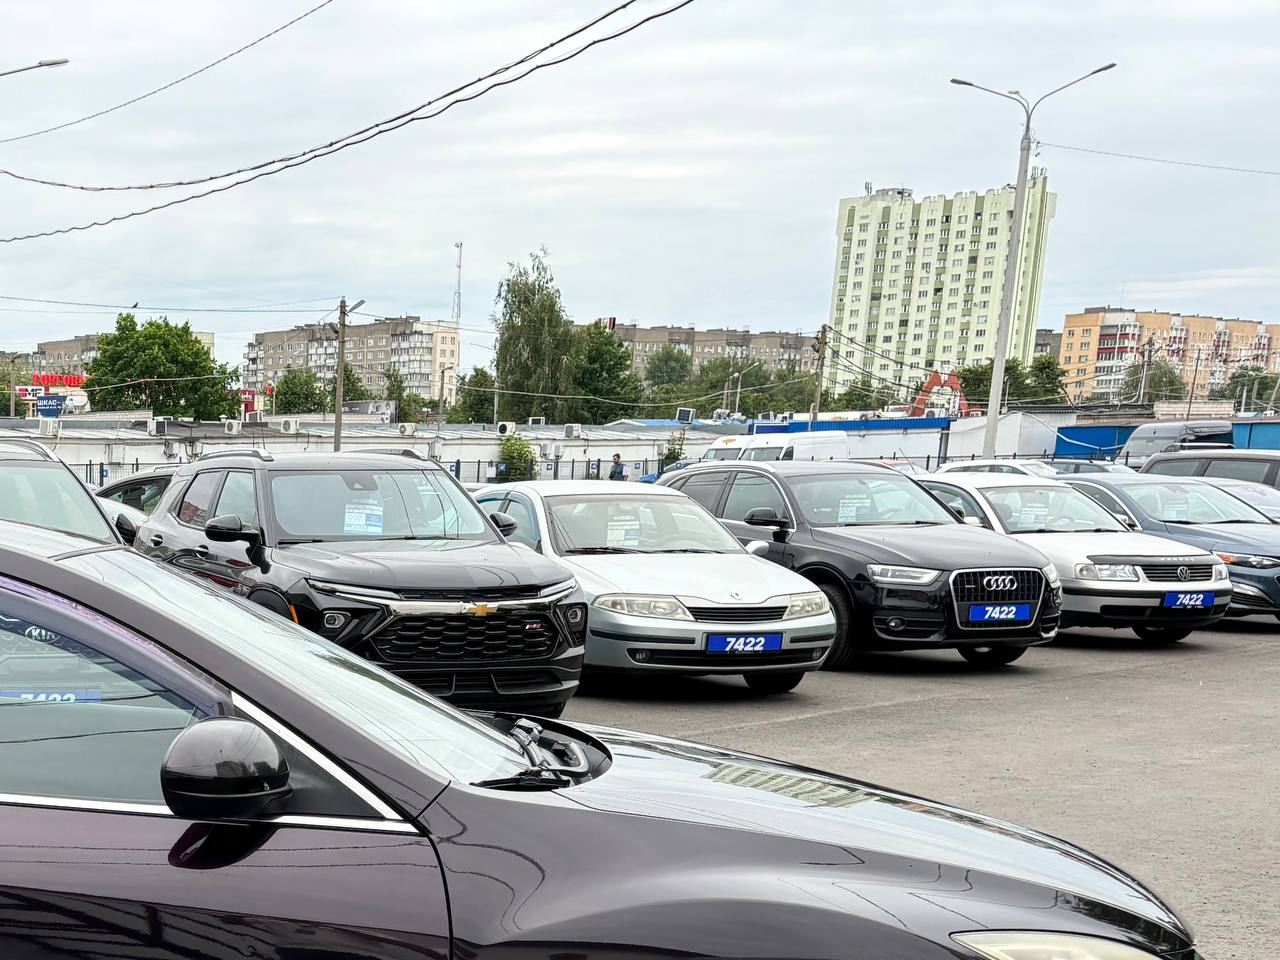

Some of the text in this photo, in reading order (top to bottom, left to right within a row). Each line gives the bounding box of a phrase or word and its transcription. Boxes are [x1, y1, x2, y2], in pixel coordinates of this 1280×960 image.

[1176, 594, 1204, 606] 7422
[984, 606, 1017, 619] 7422
[724, 637, 766, 651] 7422
